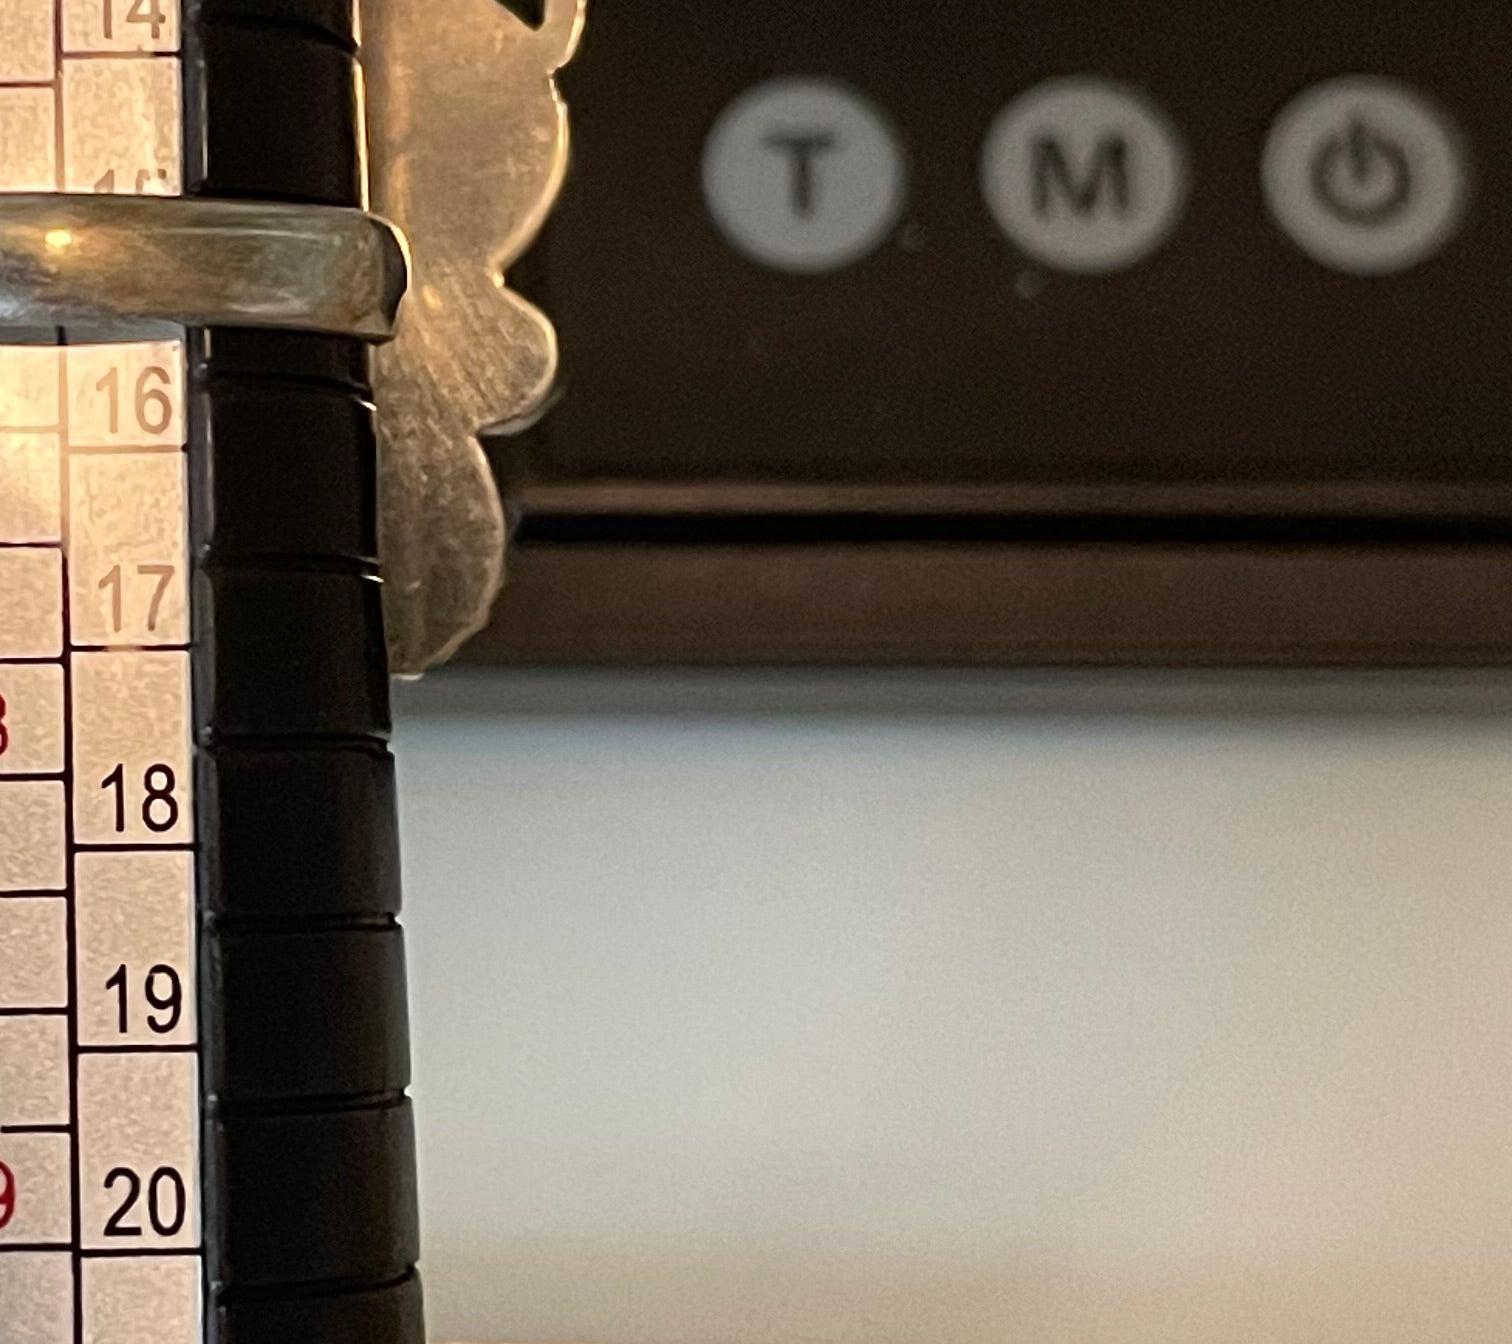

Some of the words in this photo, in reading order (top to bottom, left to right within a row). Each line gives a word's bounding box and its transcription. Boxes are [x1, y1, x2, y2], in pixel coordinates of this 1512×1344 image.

[764, 128, 836, 221] T
[1029, 131, 1131, 220] M
[94, 366, 172, 435] 16
[98, 564, 175, 633] 17
[100, 764, 179, 833] 18
[105, 964, 182, 1034] 19
[103, 1167, 186, 1237] 20
